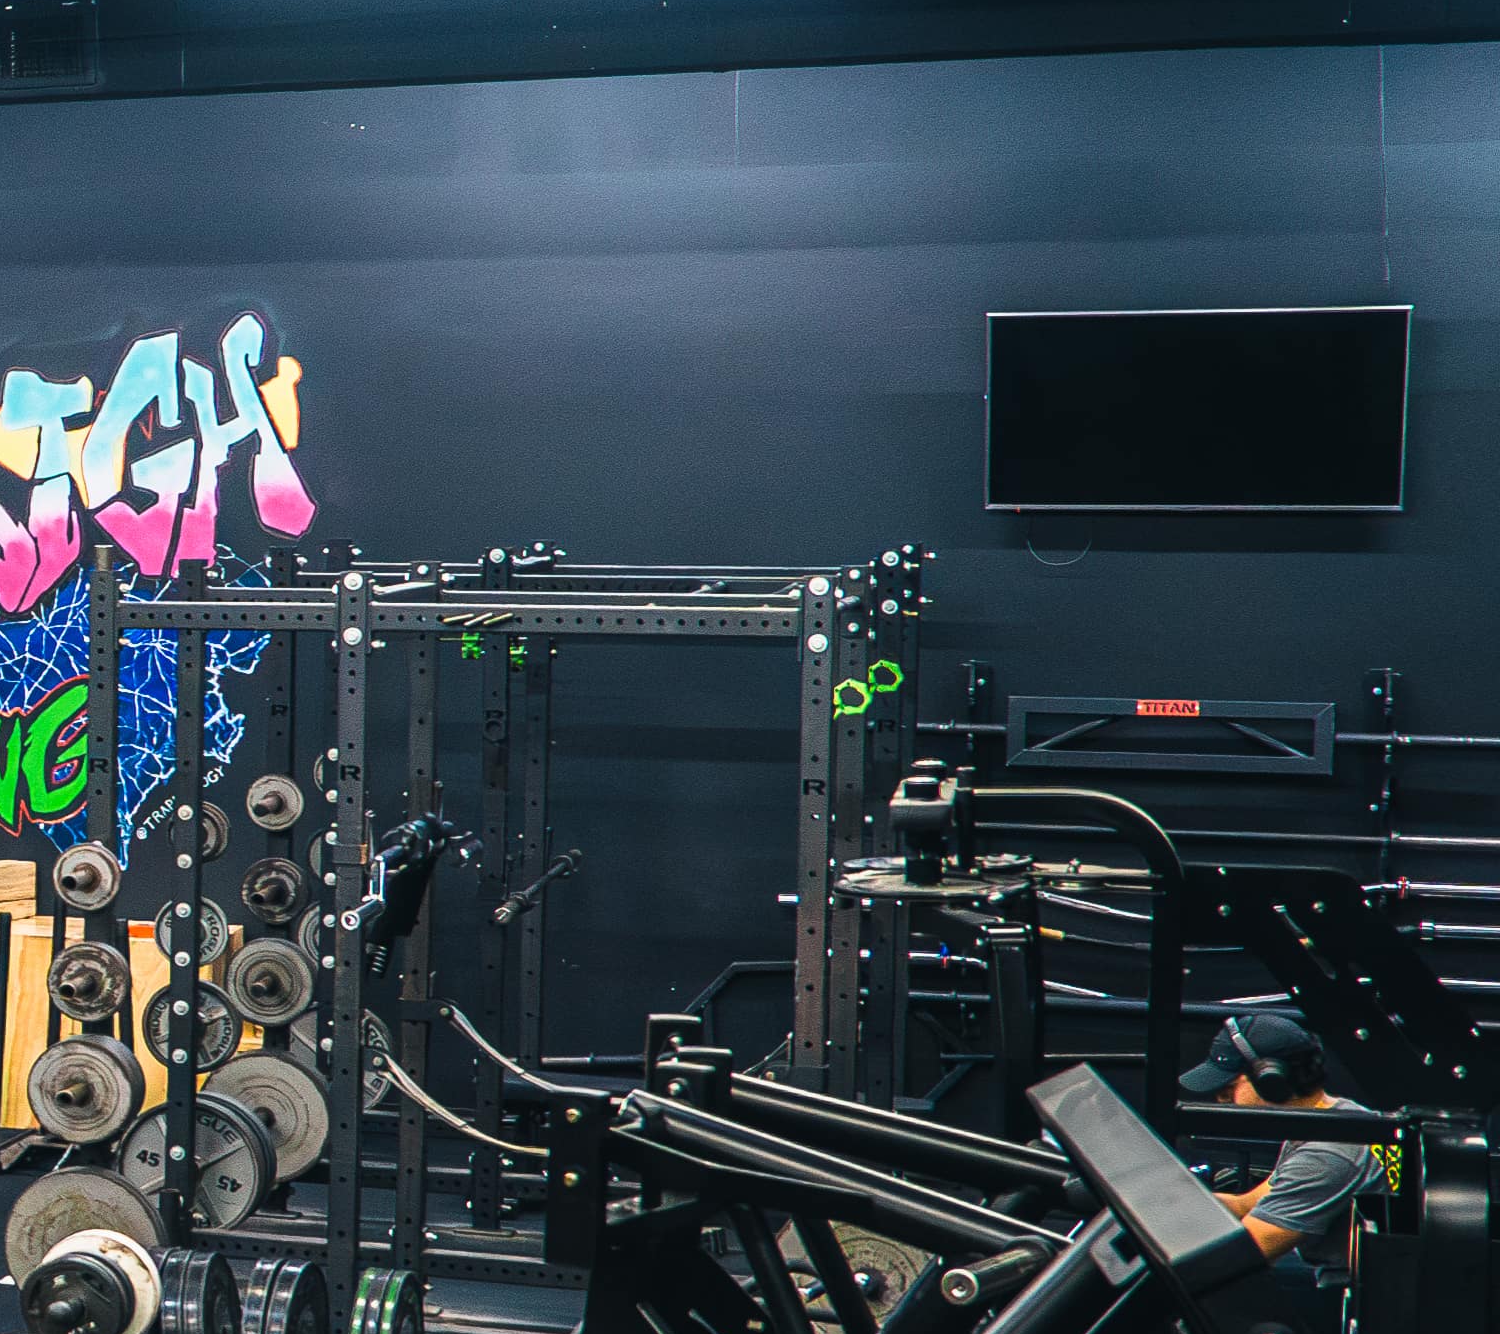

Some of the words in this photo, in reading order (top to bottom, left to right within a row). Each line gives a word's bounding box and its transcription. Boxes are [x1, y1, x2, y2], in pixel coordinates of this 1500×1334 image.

[1142, 700, 1196, 715] TITAN
[90, 758, 109, 773] R
[340, 765, 362, 781] R
[803, 779, 826, 796] R
[135, 1150, 162, 1168] 45
